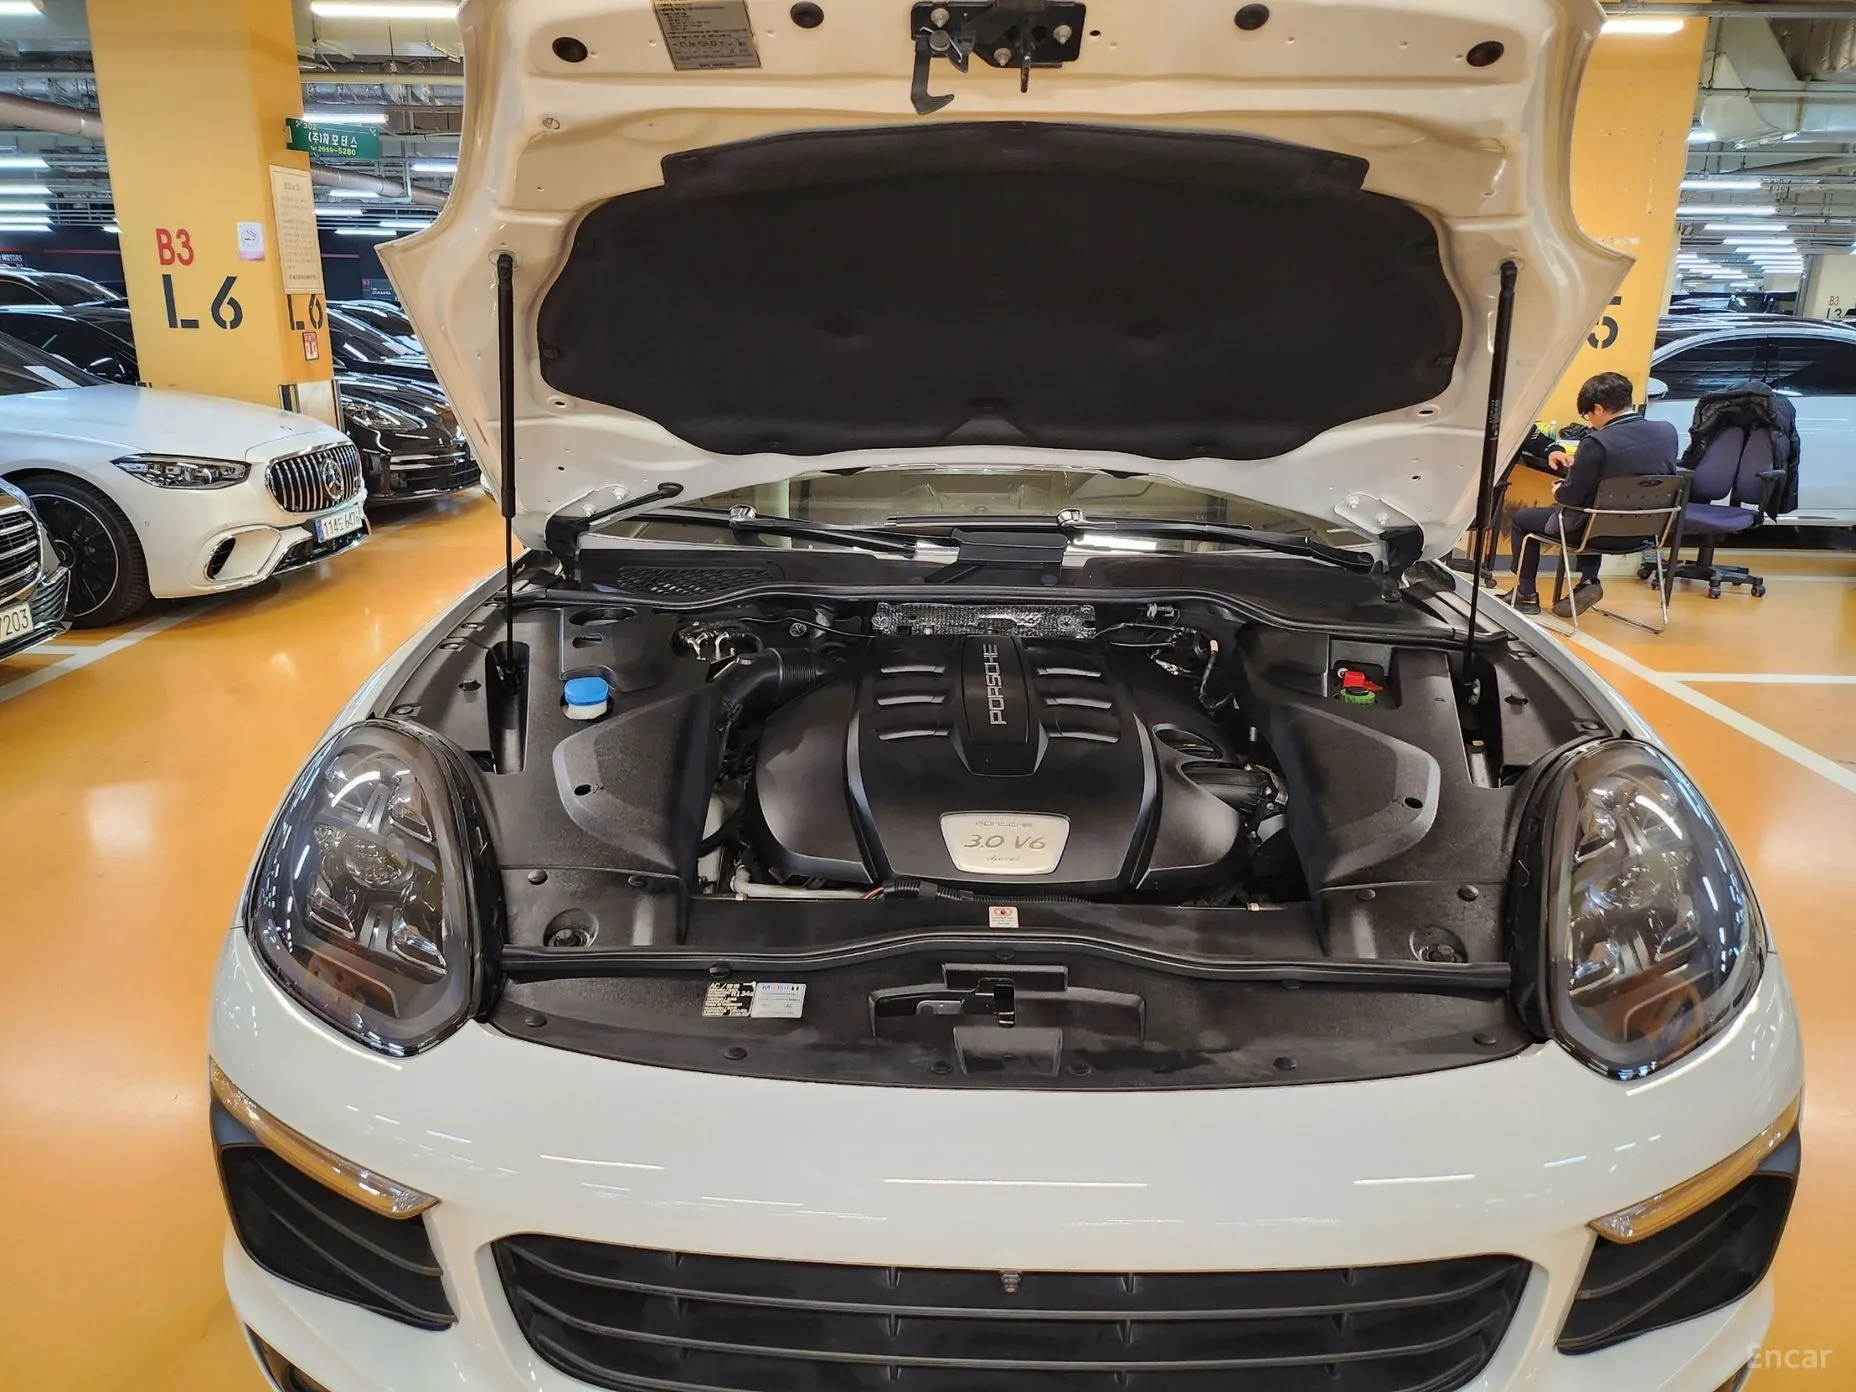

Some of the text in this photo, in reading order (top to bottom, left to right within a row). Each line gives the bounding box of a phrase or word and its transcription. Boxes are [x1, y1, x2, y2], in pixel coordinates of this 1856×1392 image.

[303, 122, 317, 131] 302
[156, 228, 194, 266] B3
[1829, 295, 1840, 306] B3
[0, 608, 28, 636] 203
[982, 643, 1007, 725] PORSCHE
[964, 834, 1046, 850] 3.0 V6
